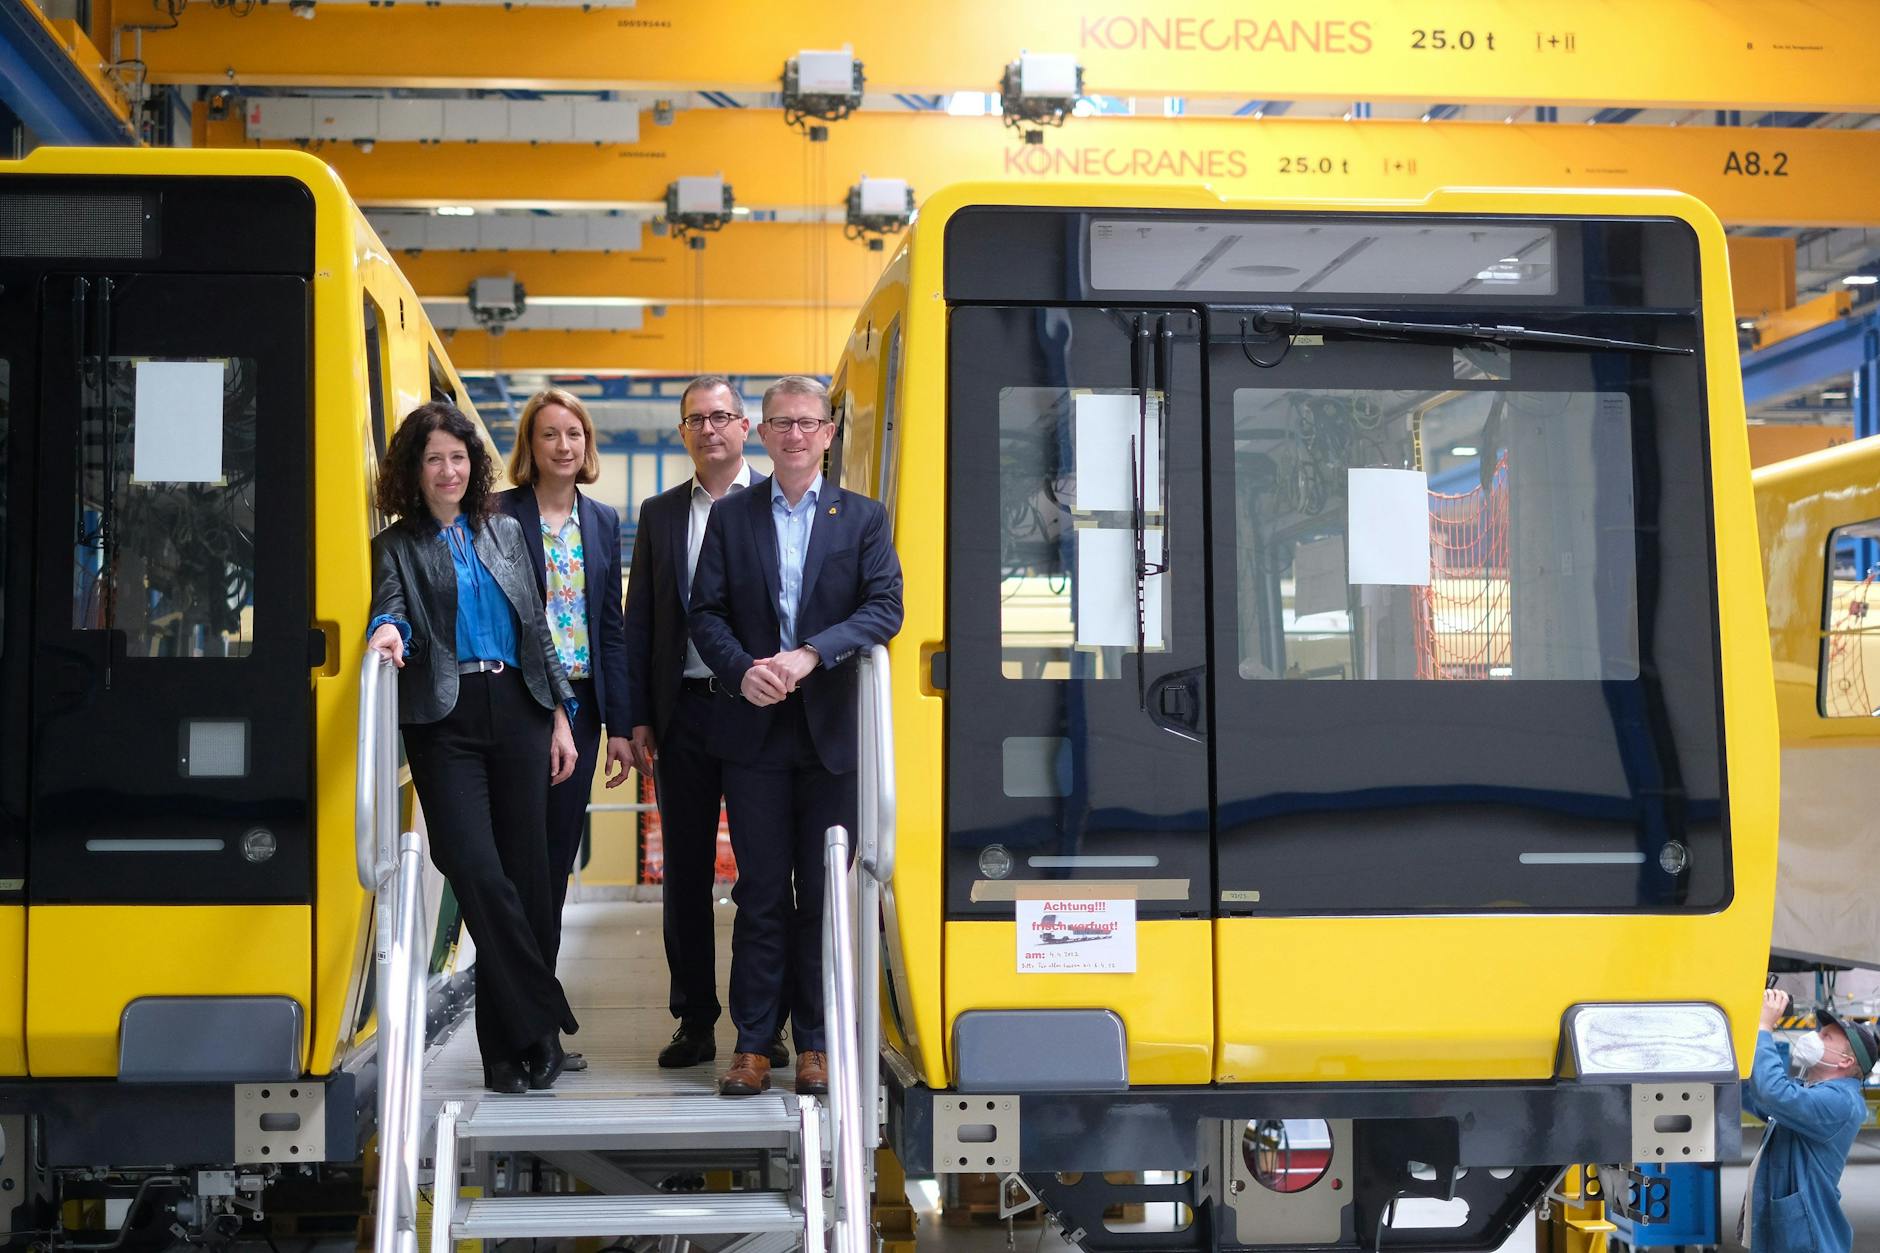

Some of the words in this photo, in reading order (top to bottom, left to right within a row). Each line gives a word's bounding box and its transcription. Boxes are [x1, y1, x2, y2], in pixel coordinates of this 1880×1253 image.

[1080, 15, 1373, 55] KONECRANES
[1411, 29, 1475, 50] 25.0
[1486, 31, 1495, 51] t
[1003, 145, 1247, 178] KONECRANES
[1279, 156, 1332, 174] 25.0
[1342, 158, 1349, 175] t
[1723, 151, 1789, 176] A8.2
[1043, 901, 1106, 912] Achtung!!!
[1032, 921, 1066, 931] frisch
